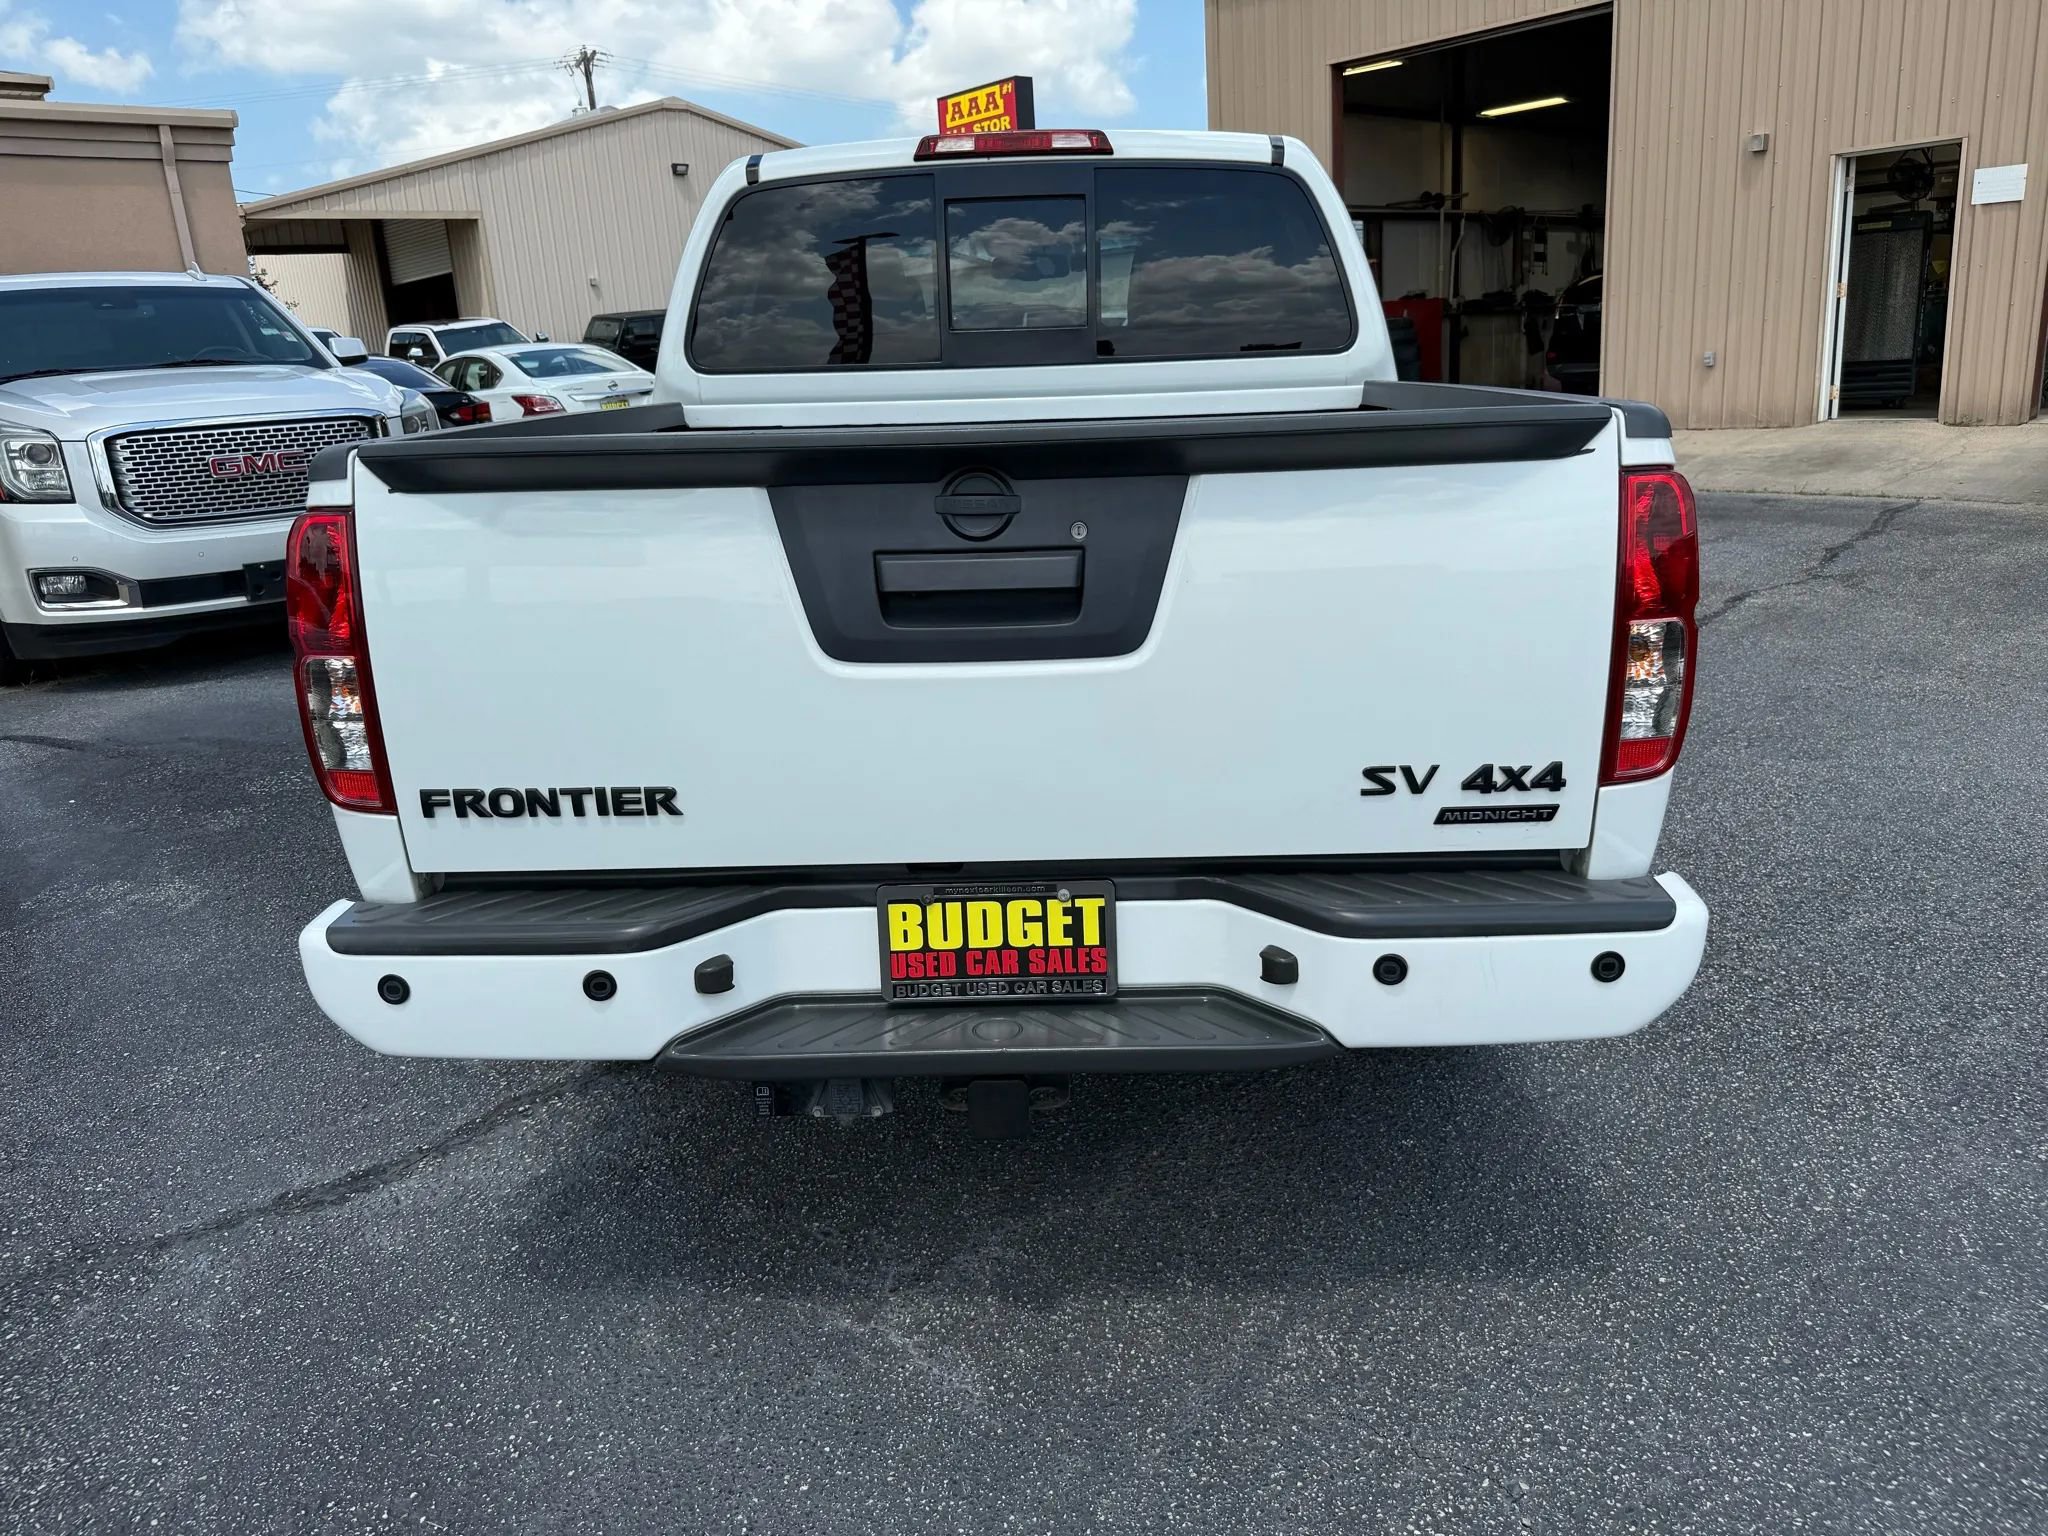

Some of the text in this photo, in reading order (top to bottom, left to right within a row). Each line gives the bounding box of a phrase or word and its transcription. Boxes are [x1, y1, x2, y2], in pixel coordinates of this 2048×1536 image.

[951, 91, 999, 122] AAA
[209, 450, 307, 478] GMC
[1360, 765, 1440, 796] SV
[419, 786, 684, 818] FRONTIER
[1443, 809, 1552, 821] MIDNIGHT
[887, 898, 1105, 951] BUDGET
[890, 947, 1107, 979] USED CAR SALES
[896, 979, 1103, 998] BUDGET USED CAR SALES
